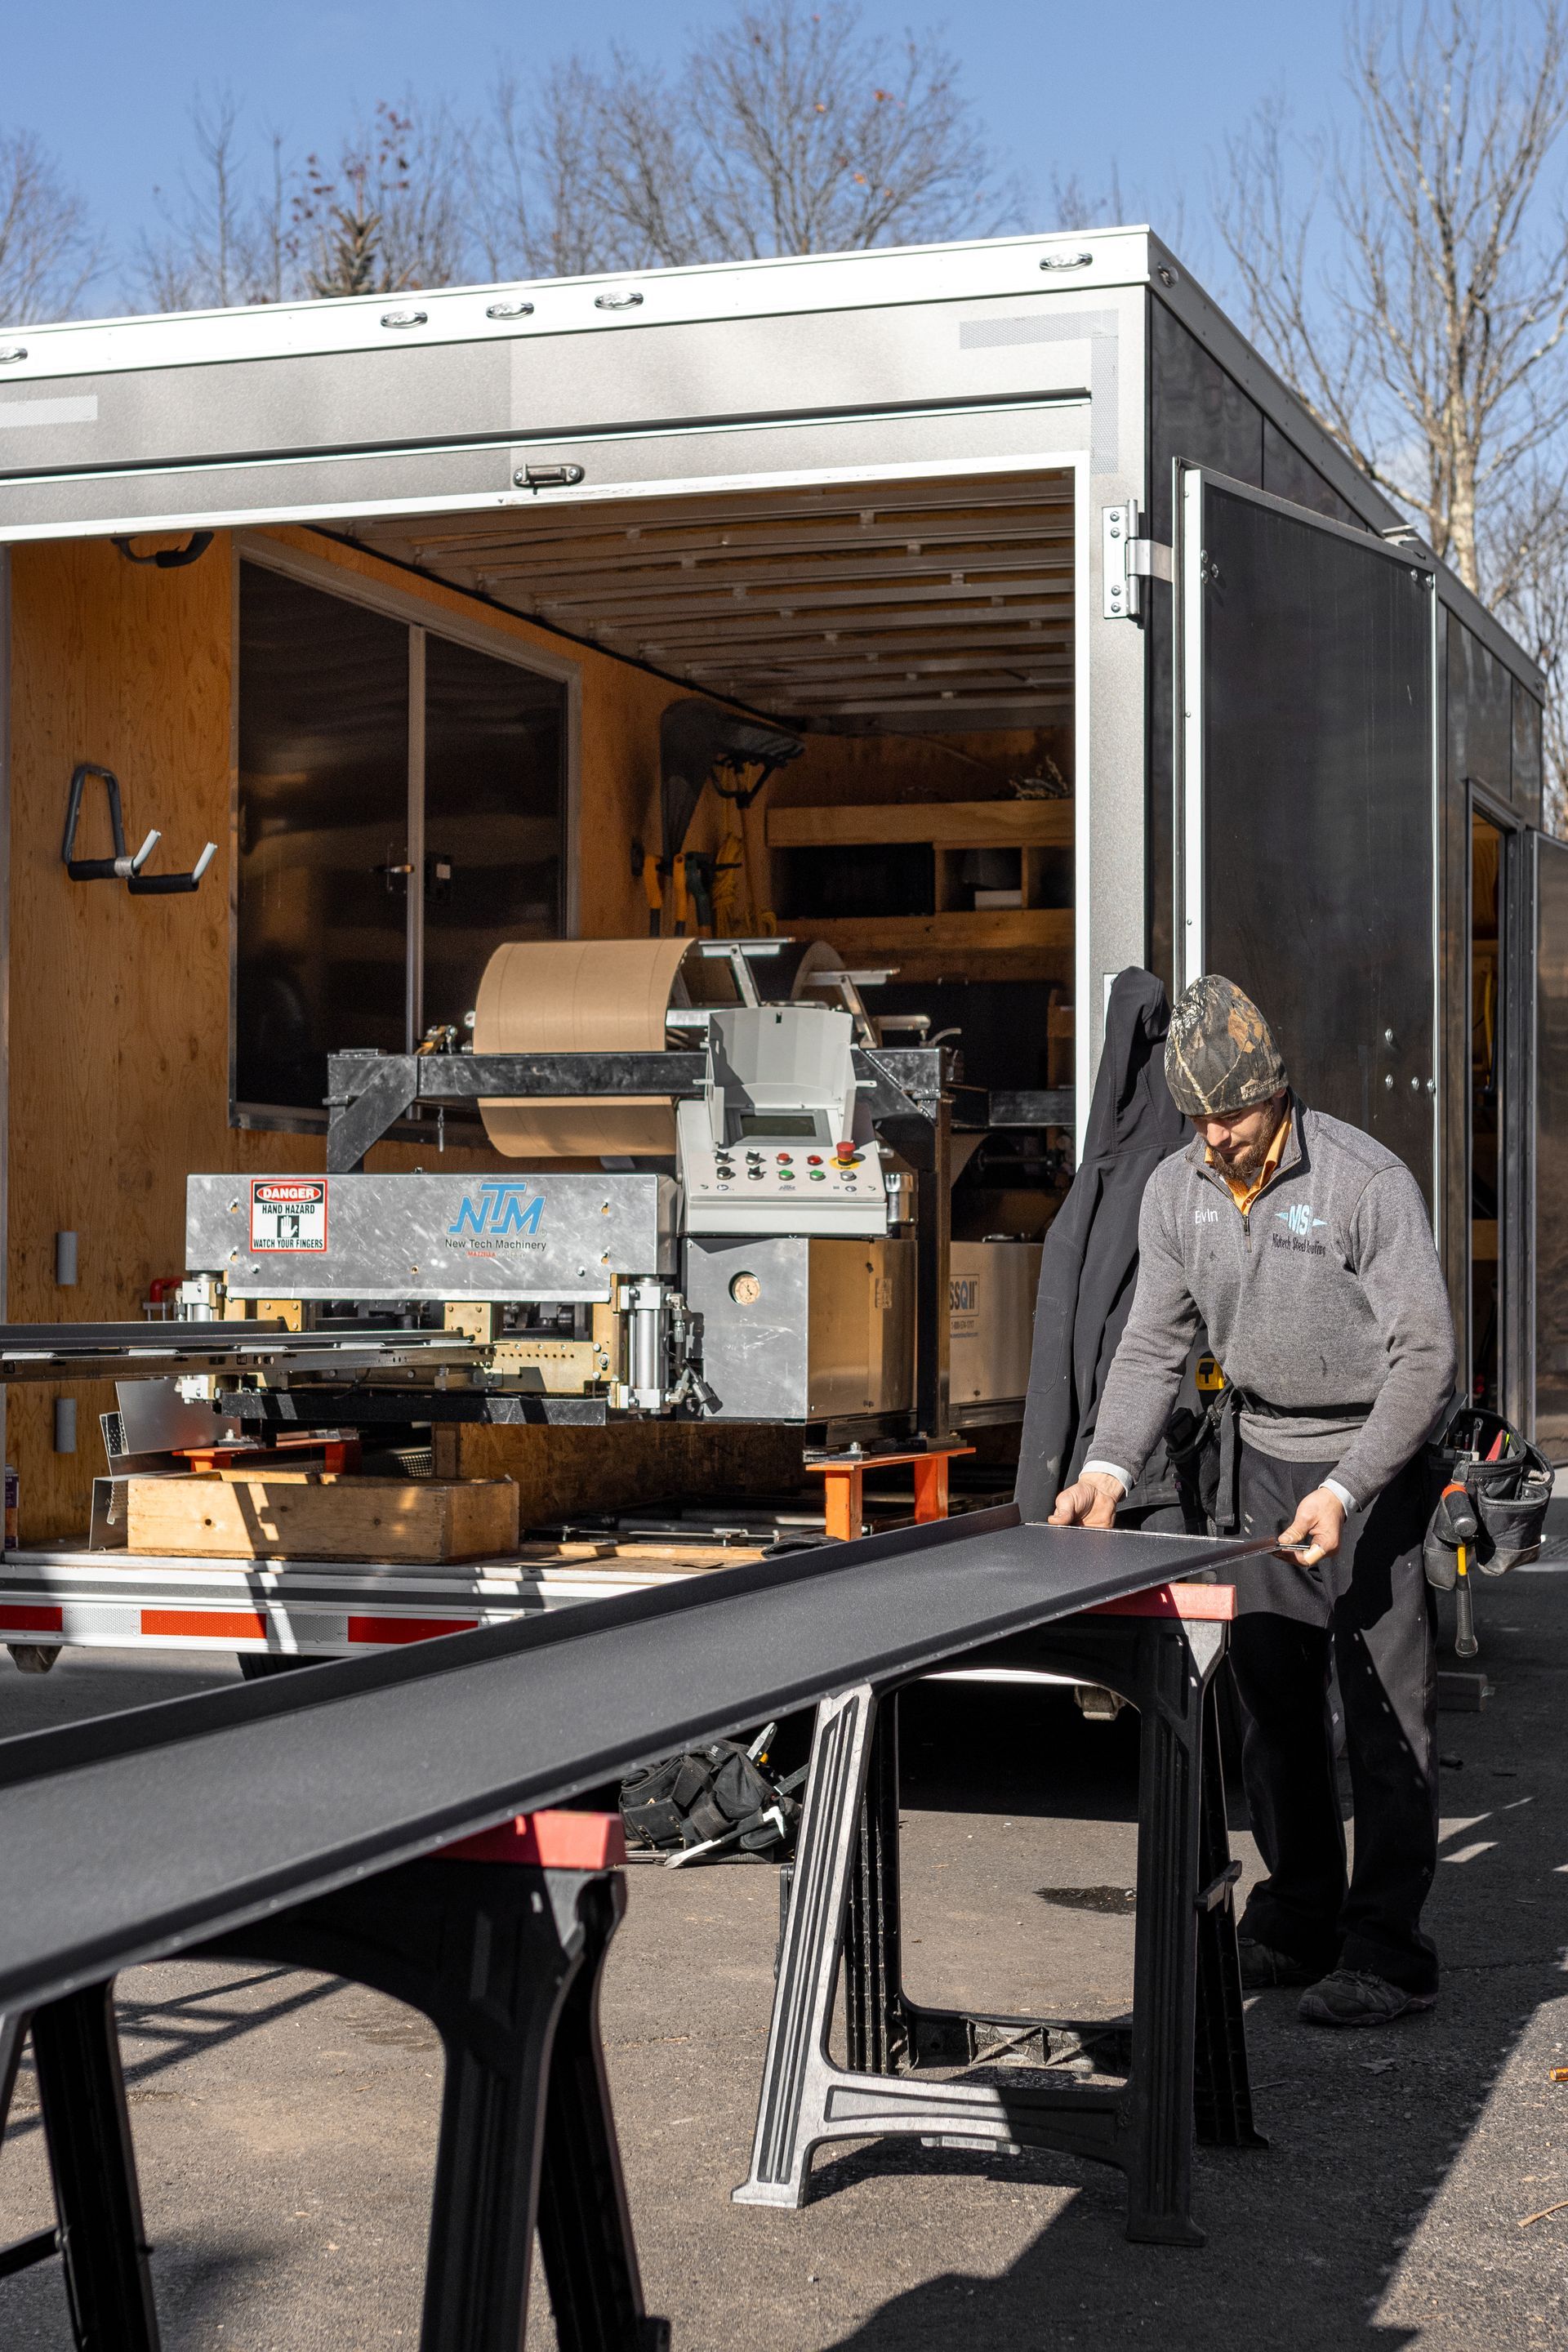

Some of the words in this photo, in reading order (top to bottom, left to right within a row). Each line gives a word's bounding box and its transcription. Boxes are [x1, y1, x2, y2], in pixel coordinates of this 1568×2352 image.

[262, 1187, 314, 1199] DANGER
[262, 1205, 283, 1214] HAND
[285, 1205, 315, 1214] HAZARD
[447, 1182, 546, 1235] NTM
[253, 1239, 275, 1248] WATCH
[278, 1239, 294, 1248] YOUR
[296, 1239, 323, 1249] FINGERS
[445, 1239, 466, 1248] New
[470, 1239, 492, 1249] Tech
[495, 1240, 546, 1251] Machinery
